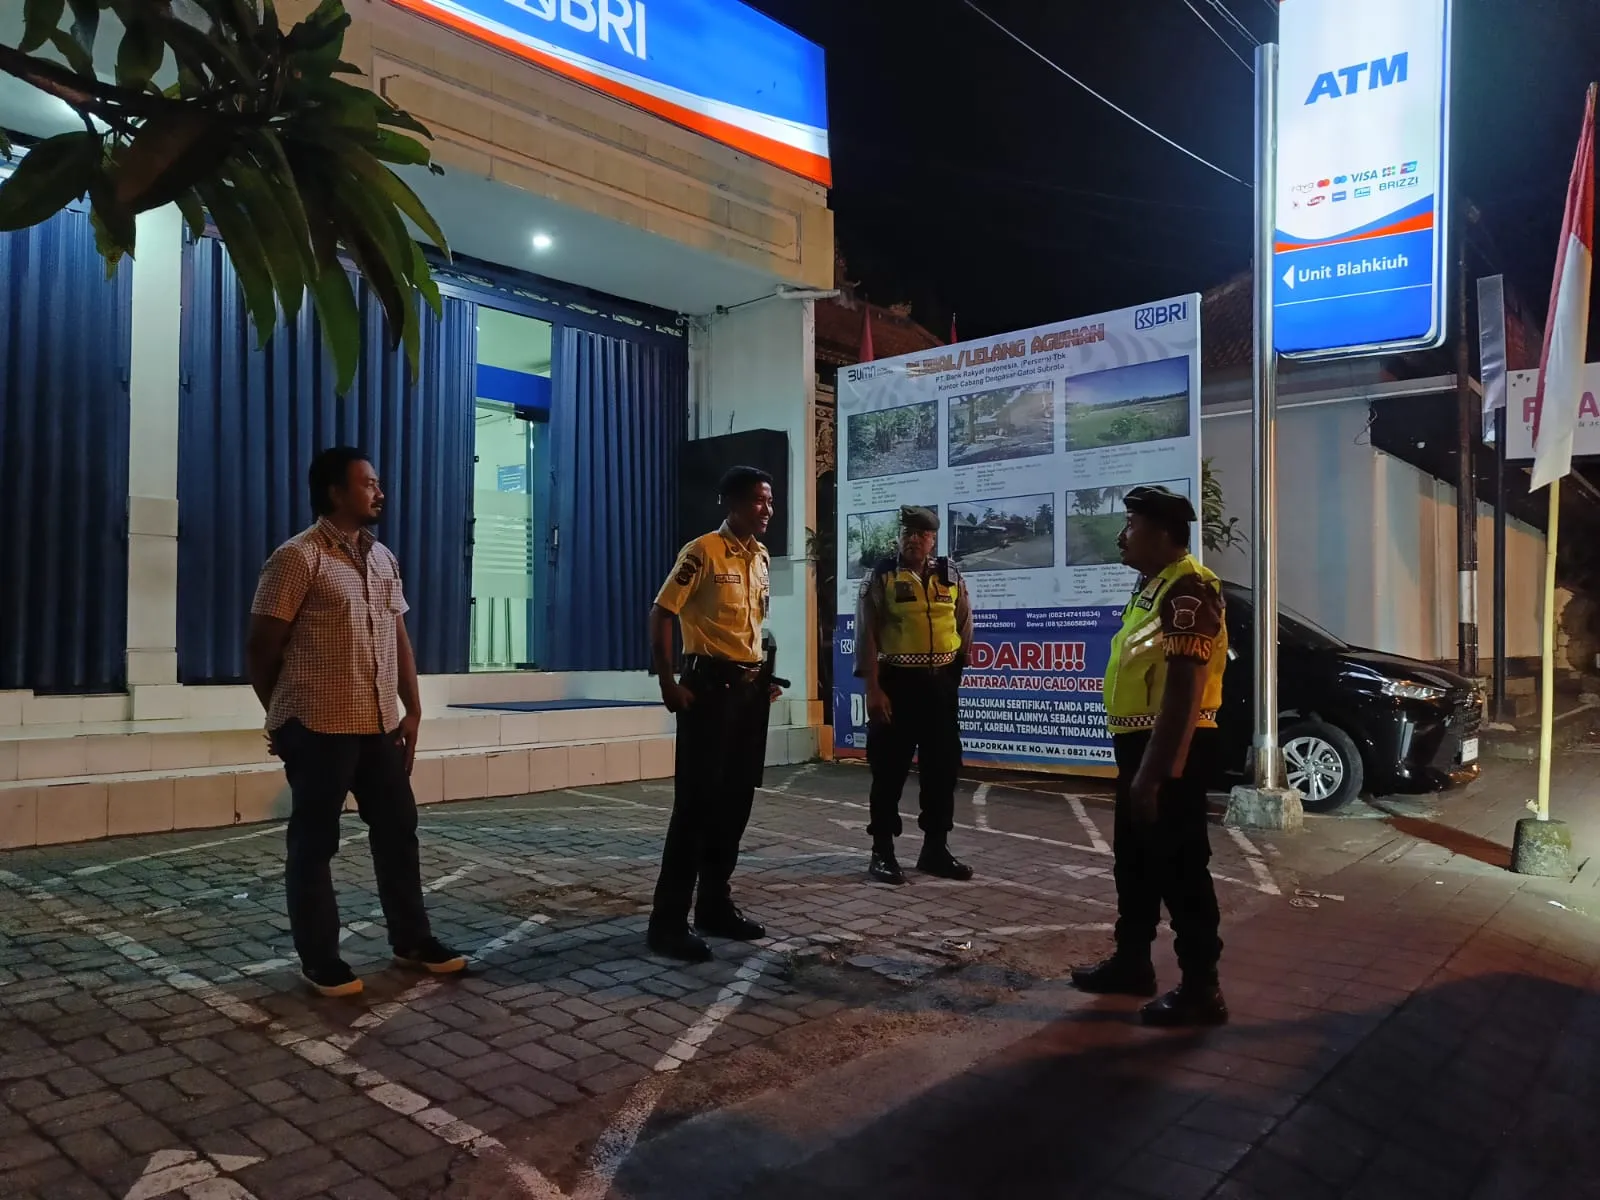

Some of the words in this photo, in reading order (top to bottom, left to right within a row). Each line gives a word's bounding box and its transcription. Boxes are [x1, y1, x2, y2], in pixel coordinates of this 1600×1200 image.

[1304, 51, 1409, 105] ATM
[1351, 169, 1378, 182] VISA
[1379, 176, 1419, 191] BRIZZI
[1298, 266, 1332, 283] Unit
[1336, 254, 1409, 277] Blahkiuh
[1155, 301, 1187, 325] BRI
[963, 369, 984, 377] Rakyat
[1053, 353, 1066, 361] Tbk
[960, 379, 984, 388] Cabang
[964, 641, 1086, 672] DARI!!!
[960, 675, 1008, 690] ANTARA
[1009, 676, 1041, 690] ATAU
[1043, 676, 1077, 691] CALO
[1006, 699, 1053, 712] SERTIFIKAT,
[1053, 701, 1083, 712] TANDA
[975, 710, 1013, 720] DOKUMEN
[1014, 711, 1049, 722] LAINNYA
[1050, 713, 1086, 724] SEBAGAI
[957, 721, 983, 732] REDIT,
[984, 722, 1015, 733] KARENA
[1016, 723, 1059, 735] TERMASUK
[1060, 726, 1105, 738] TINDAKAN
[970, 741, 1014, 751] LAPORKAN
[1016, 744, 1027, 752] KE
[1029, 745, 1044, 753] NO.
[1045, 746, 1060, 755] WA
[1067, 748, 1087, 756] 0821
[1090, 750, 1112, 758] 4479
